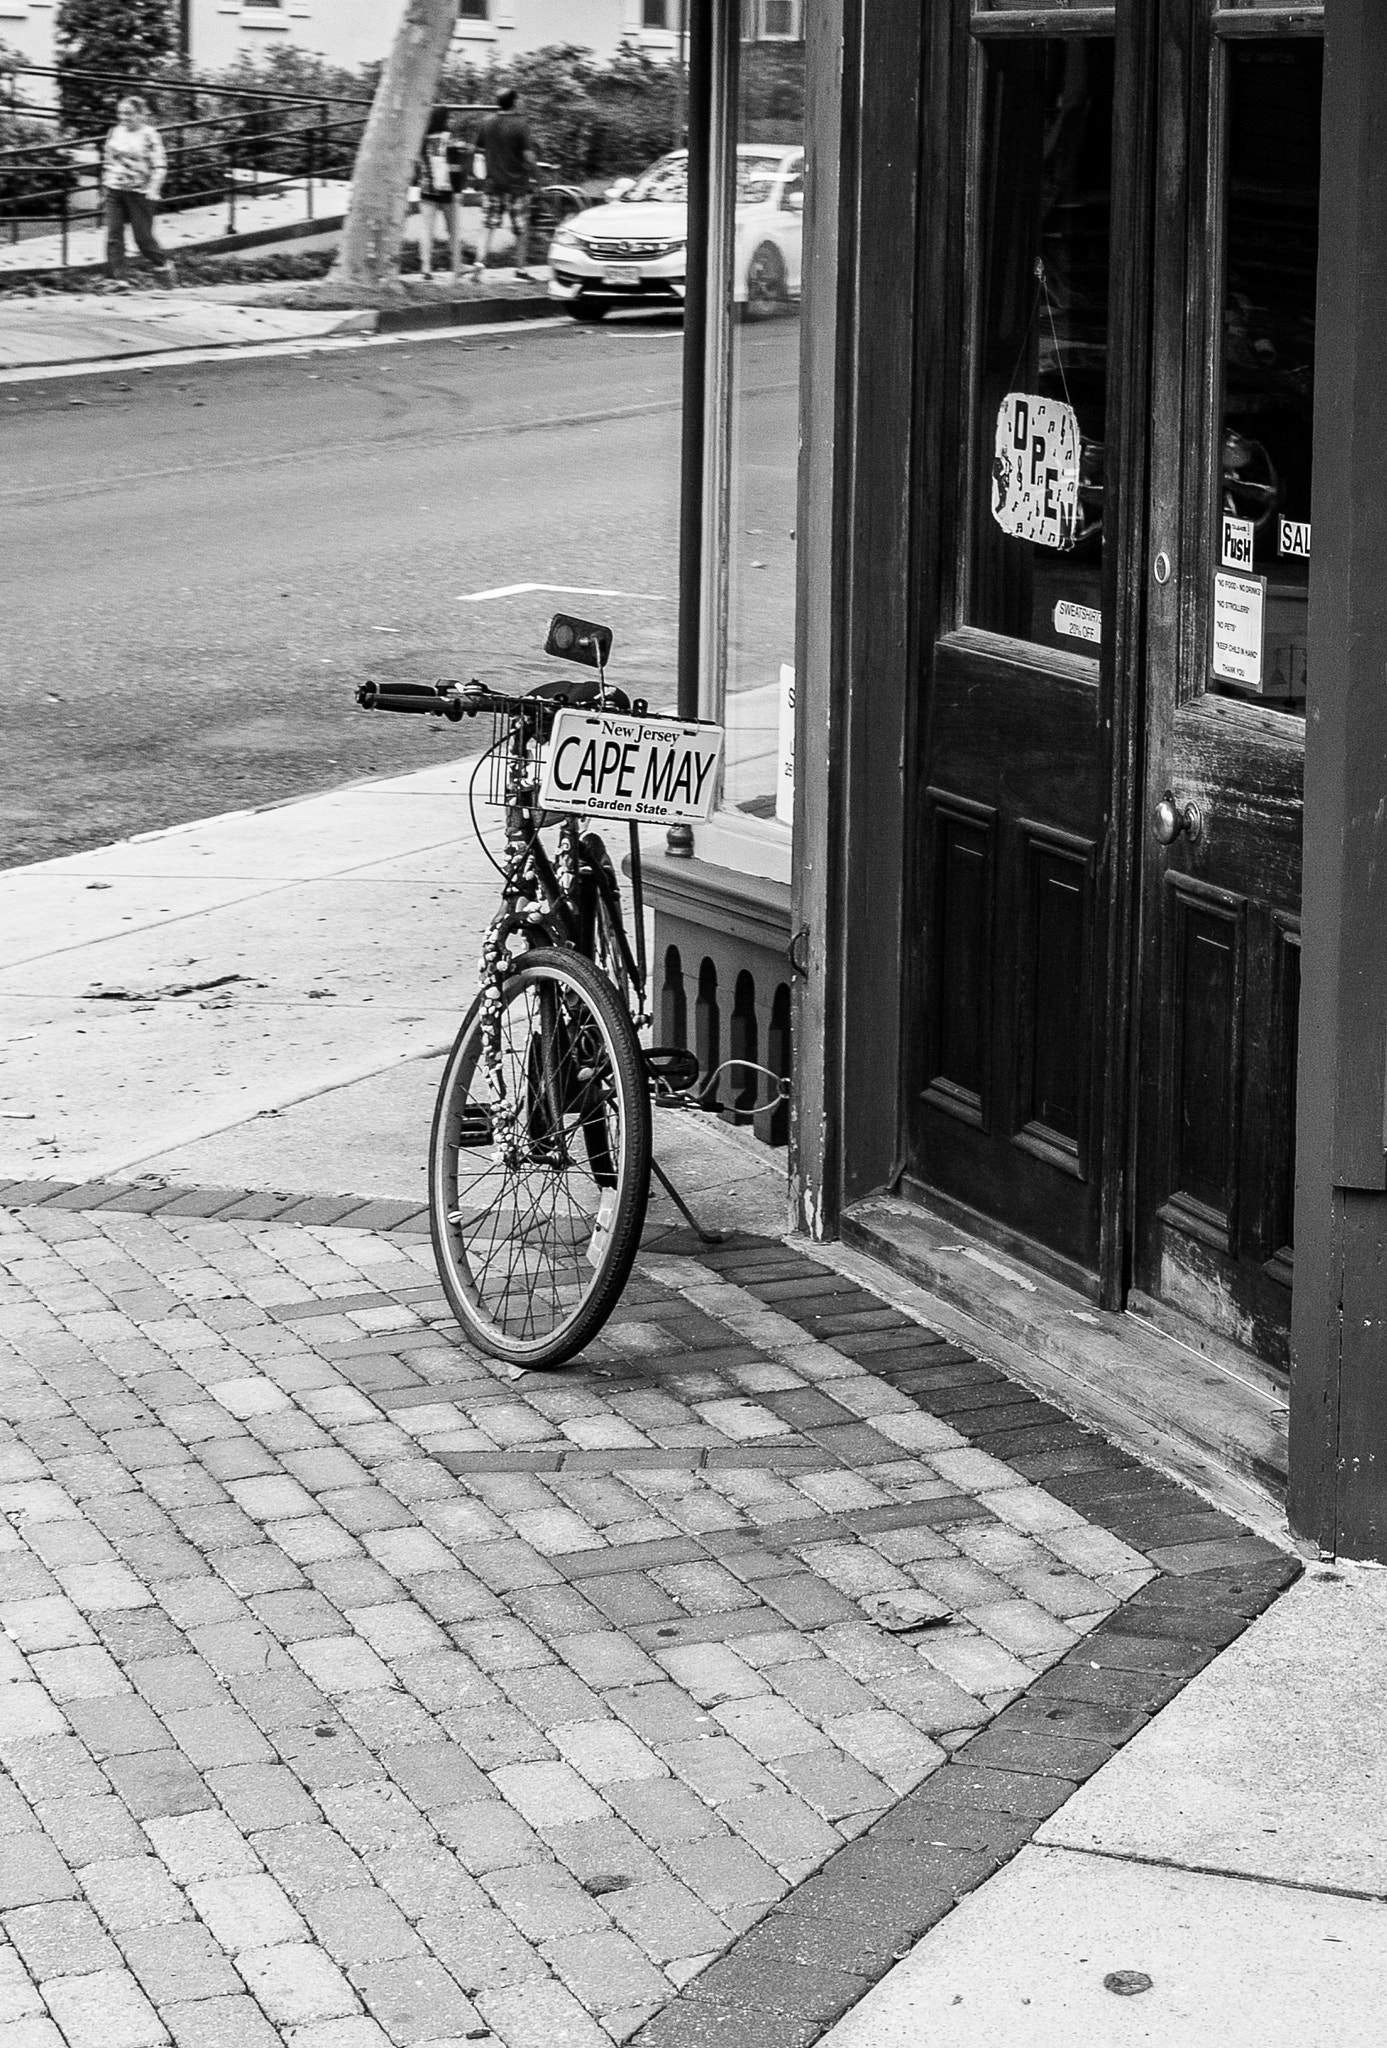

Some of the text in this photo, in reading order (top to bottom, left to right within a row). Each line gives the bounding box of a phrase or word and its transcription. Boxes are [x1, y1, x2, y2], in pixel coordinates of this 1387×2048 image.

[1082, 625, 1094, 639] OFF
[601, 720, 681, 747] New Jersey
[553, 736, 716, 805] CAPE MAY
[587, 797, 668, 816] Garden State
